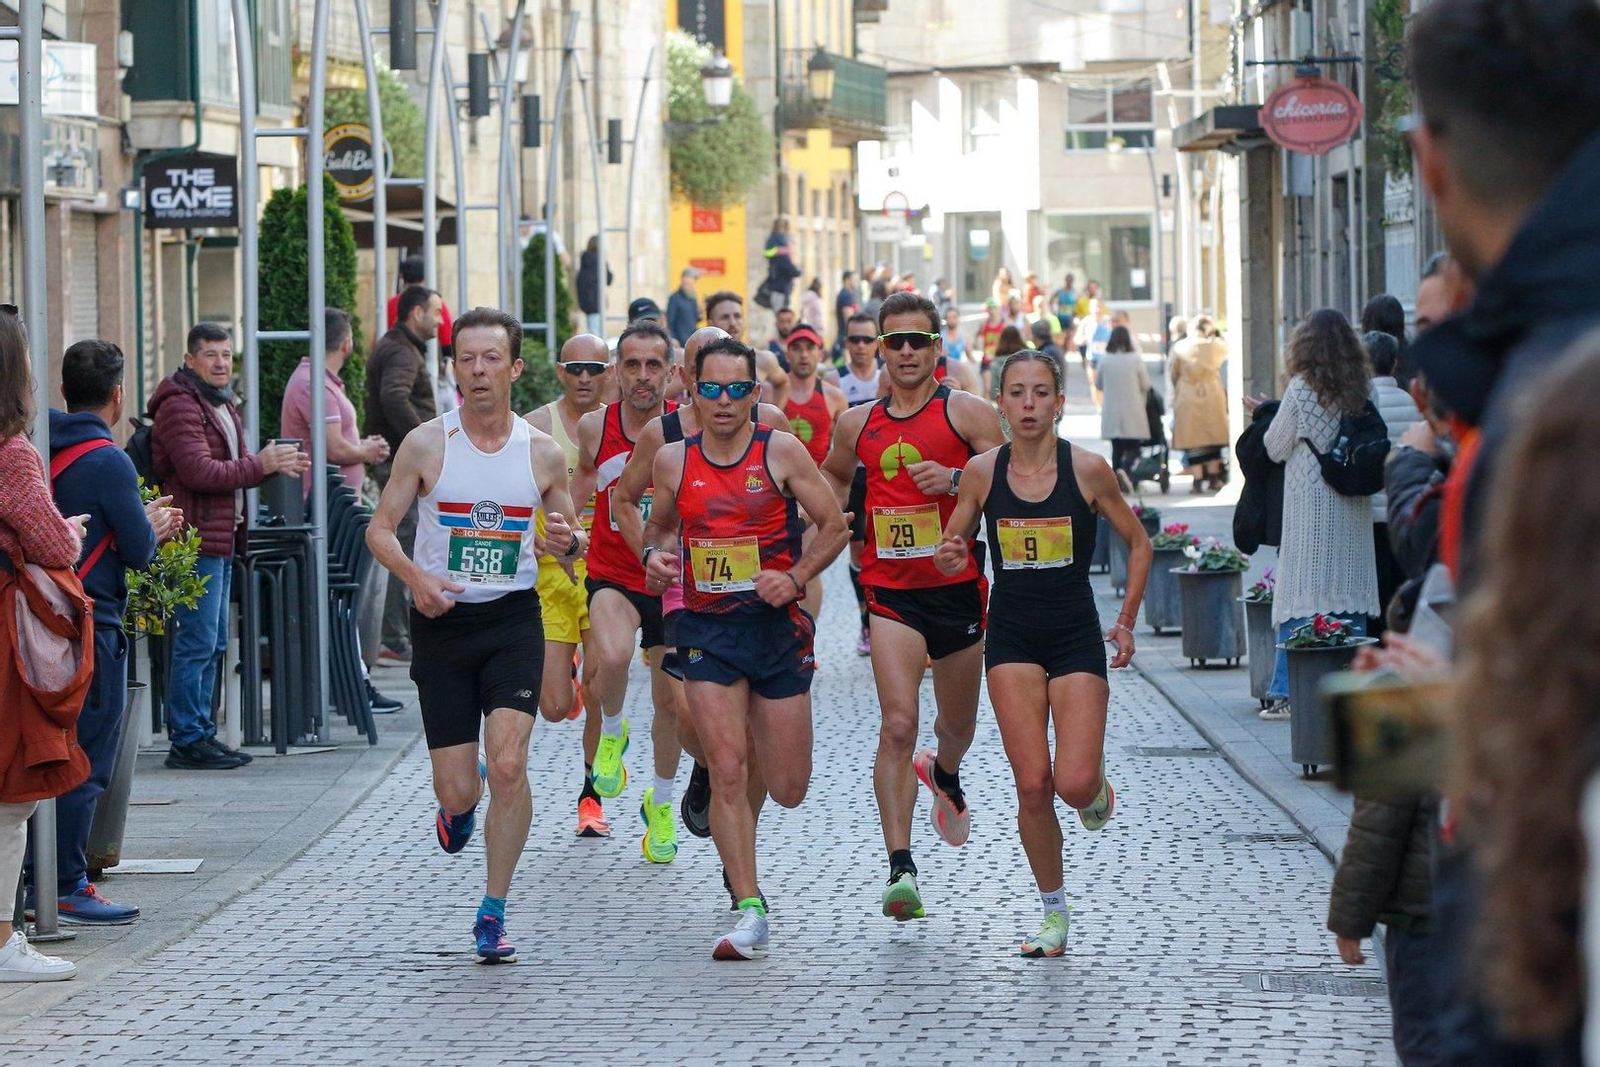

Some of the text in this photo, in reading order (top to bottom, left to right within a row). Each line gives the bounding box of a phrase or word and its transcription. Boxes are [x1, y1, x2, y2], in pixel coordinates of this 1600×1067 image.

[166, 168, 215, 187] THE
[151, 186, 233, 209] GAME
[890, 524, 915, 548] 29
[460, 546, 503, 574] 538
[1025, 537, 1037, 561] 9
[706, 557, 732, 581] 74
